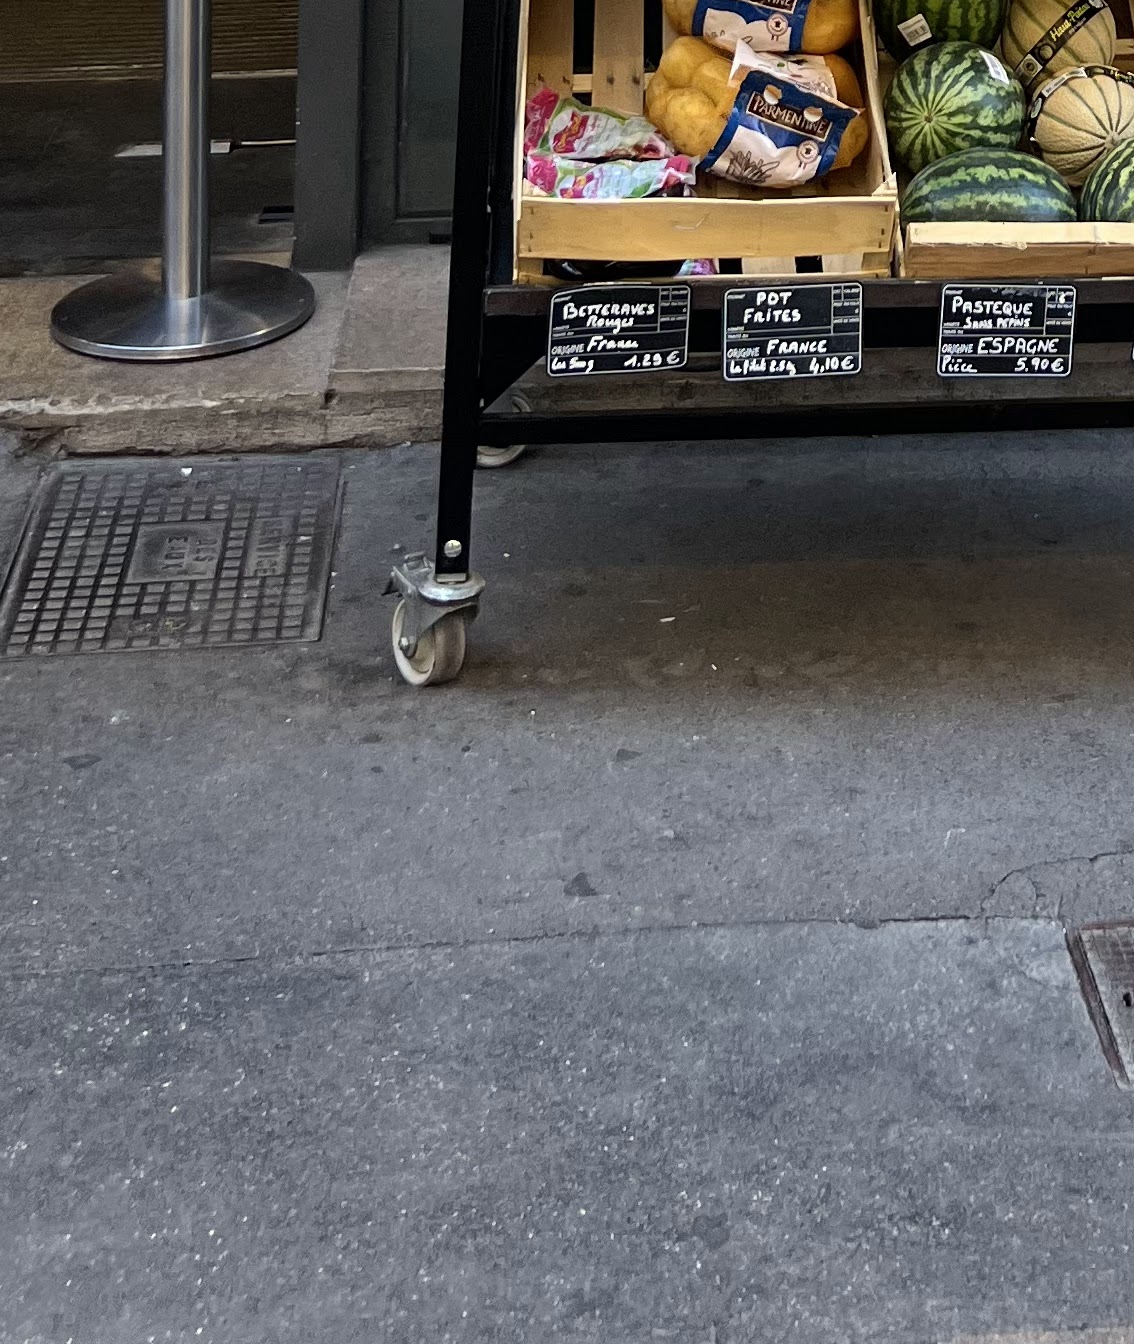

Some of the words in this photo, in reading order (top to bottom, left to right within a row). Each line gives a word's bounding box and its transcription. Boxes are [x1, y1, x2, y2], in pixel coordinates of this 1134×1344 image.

[563, 303, 655, 320] BETTERAVES
[952, 296, 1033, 316] PASTEQUE
[743, 308, 801, 324] FRITES
[587, 336, 639, 352] France
[766, 339, 827, 355] FRANCE
[978, 337, 1059, 355] ESPAGNE
